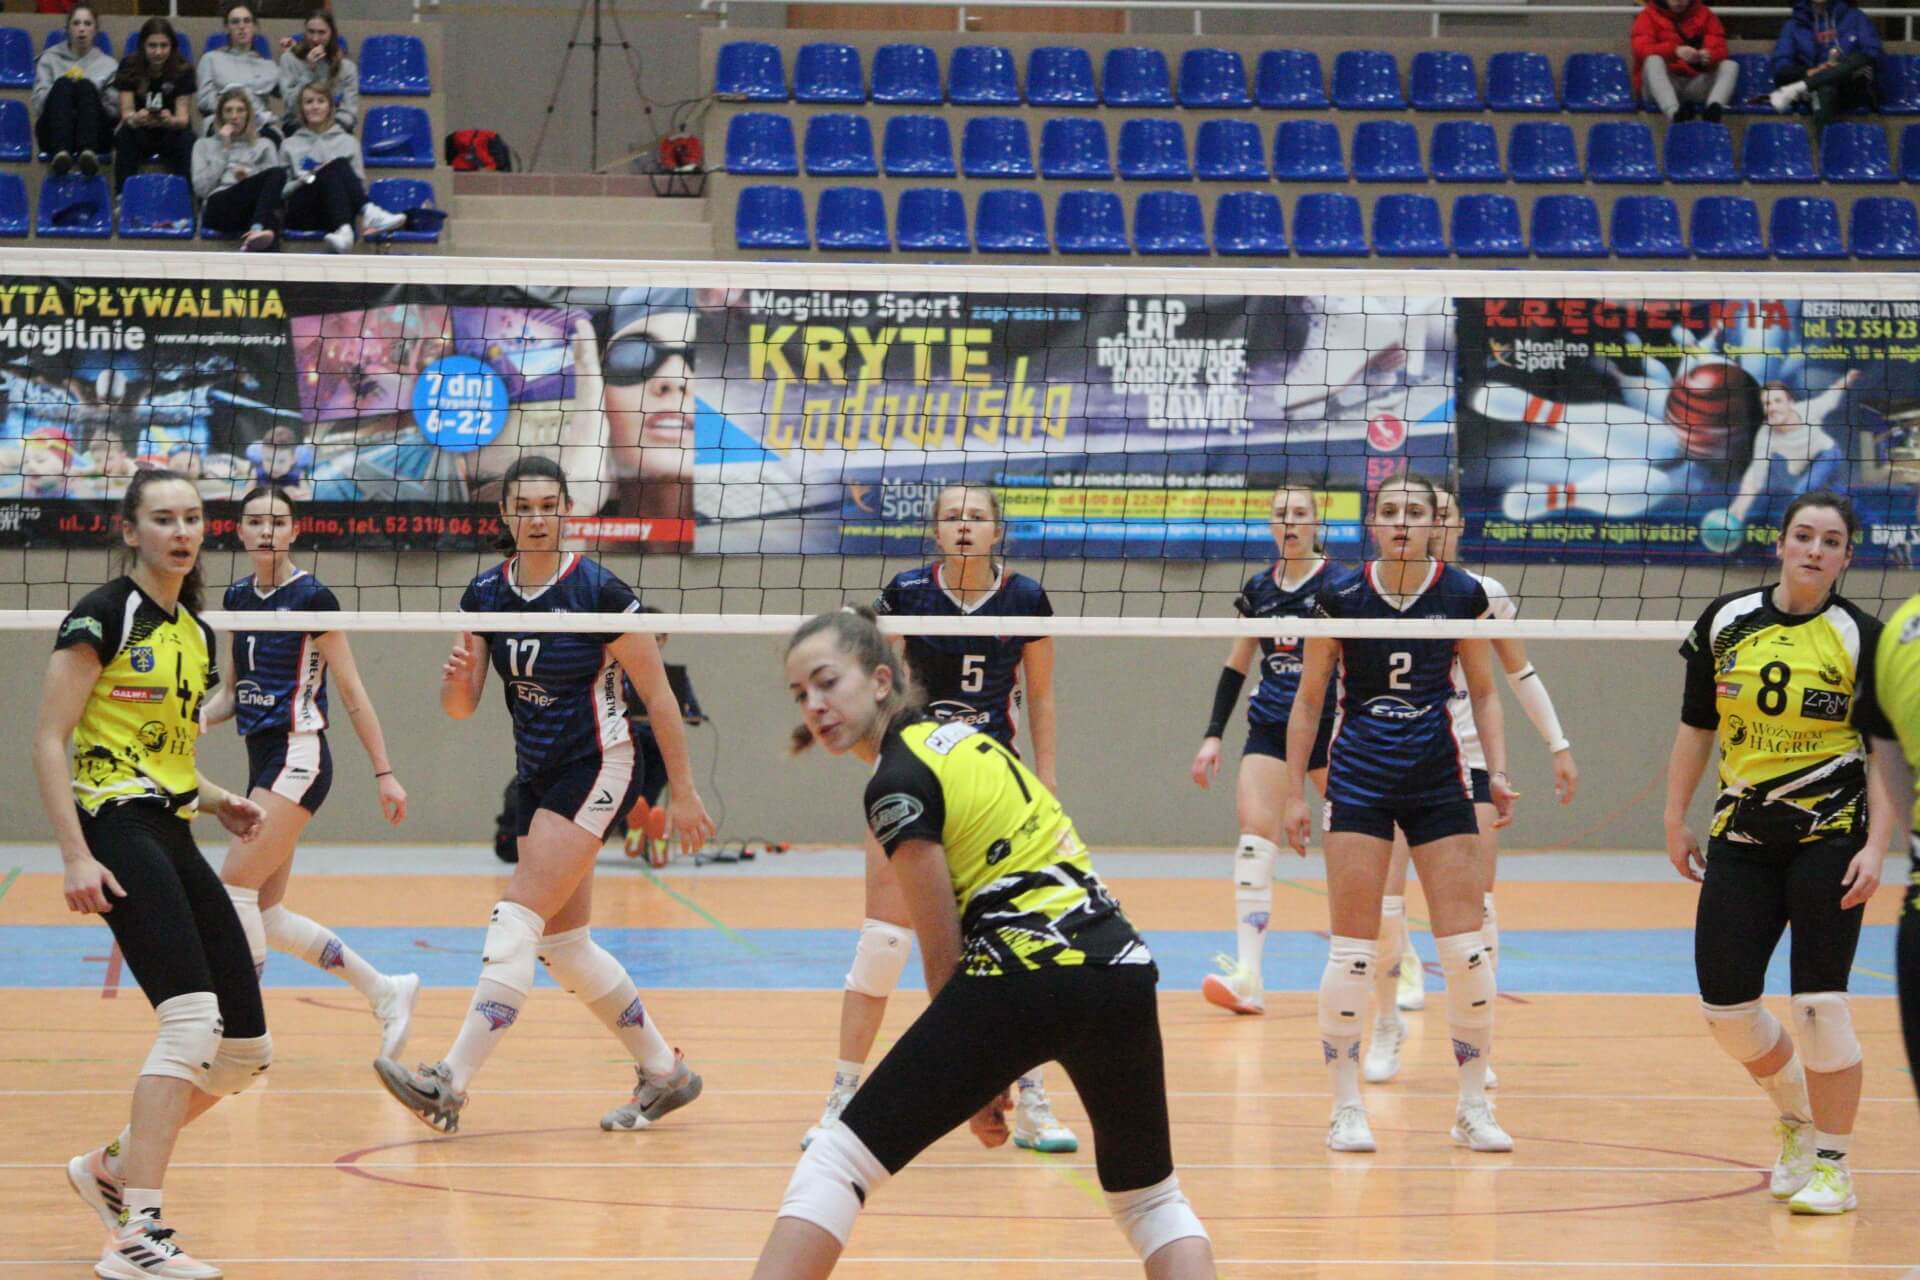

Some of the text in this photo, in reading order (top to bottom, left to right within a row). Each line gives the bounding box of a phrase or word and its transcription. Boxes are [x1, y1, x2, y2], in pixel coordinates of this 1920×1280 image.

[73, 285, 287, 319] PŁYWALNIA
[750, 290, 960, 323] Mogilno Sport
[1058, 308, 1081, 320] na
[1803, 300, 1890, 319] REZERWACJA
[1127, 299, 1187, 339] ŁAP
[1803, 319, 1918, 339] tel. 52 554 23
[749, 323, 993, 387] KRYTE
[1514, 338, 1590, 357] Mogilno
[425, 370, 493, 397] 7 dni
[426, 408, 492, 434] 6-22
[59, 516, 84, 532] ul.
[349, 515, 380, 534] tel.
[386, 516, 406, 533] 52
[450, 517, 472, 535] 06
[477, 518, 499, 535] 24
[1531, 521, 1595, 542] miejsce
[246, 635, 256, 672] 1
[506, 638, 541, 677] 17
[961, 654, 986, 693] 5
[1389, 651, 1412, 691] 2
[238, 689, 276, 707] Enea
[1756, 660, 1791, 717] 8
